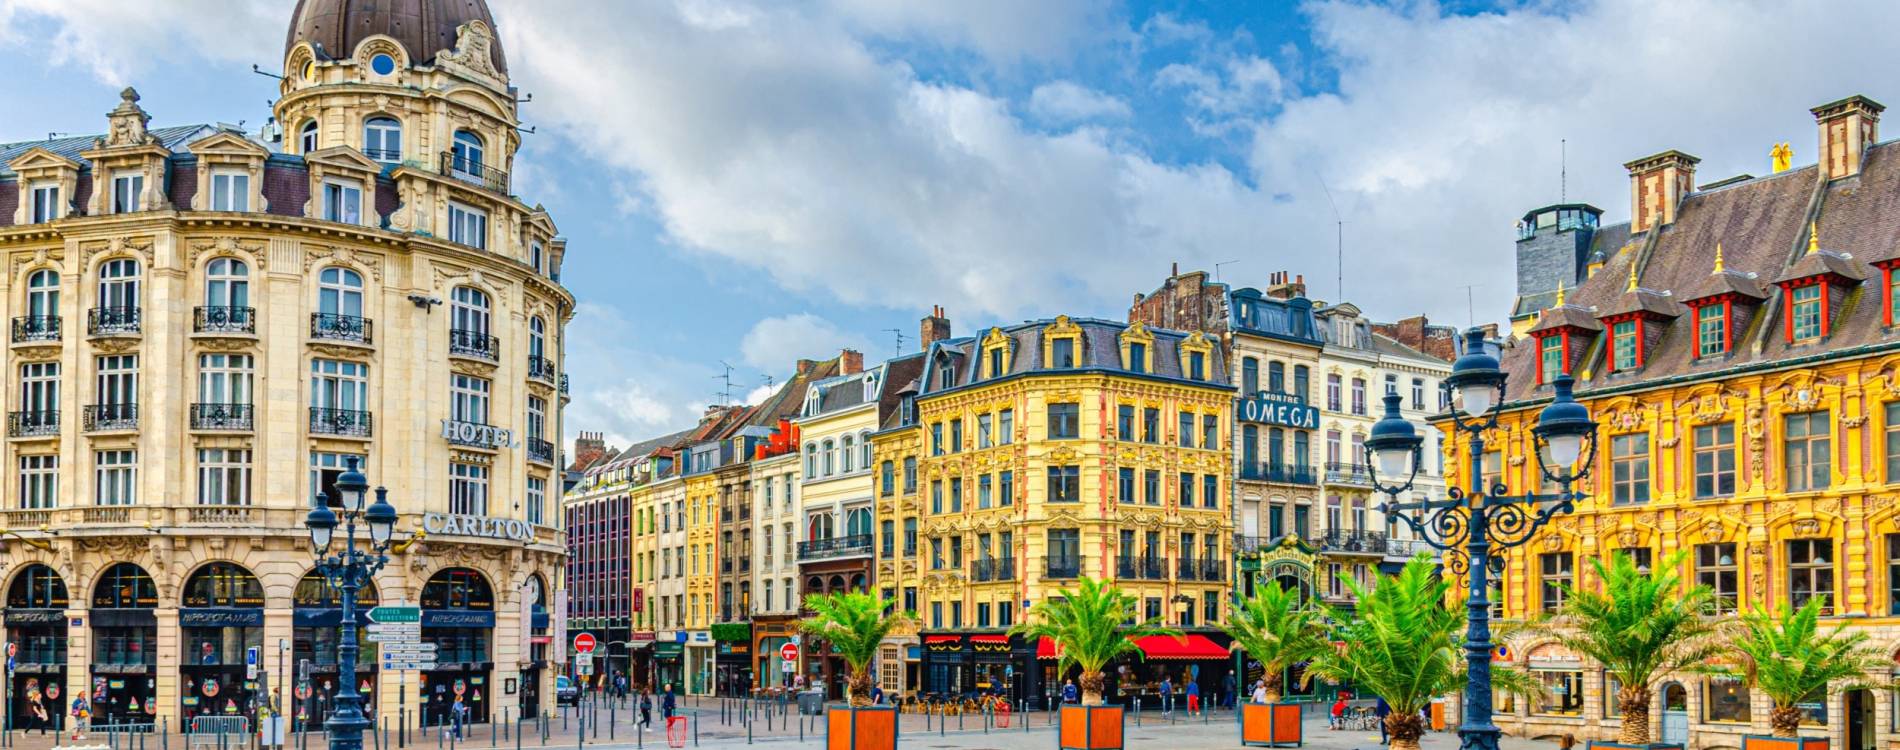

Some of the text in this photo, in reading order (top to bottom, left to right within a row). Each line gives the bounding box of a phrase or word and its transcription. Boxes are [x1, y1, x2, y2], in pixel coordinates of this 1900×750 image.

[1263, 393, 1298, 404] MONTRE
[1246, 400, 1314, 427] OMEGA
[440, 419, 520, 449] HOTEL
[424, 512, 534, 542] CARLTON
